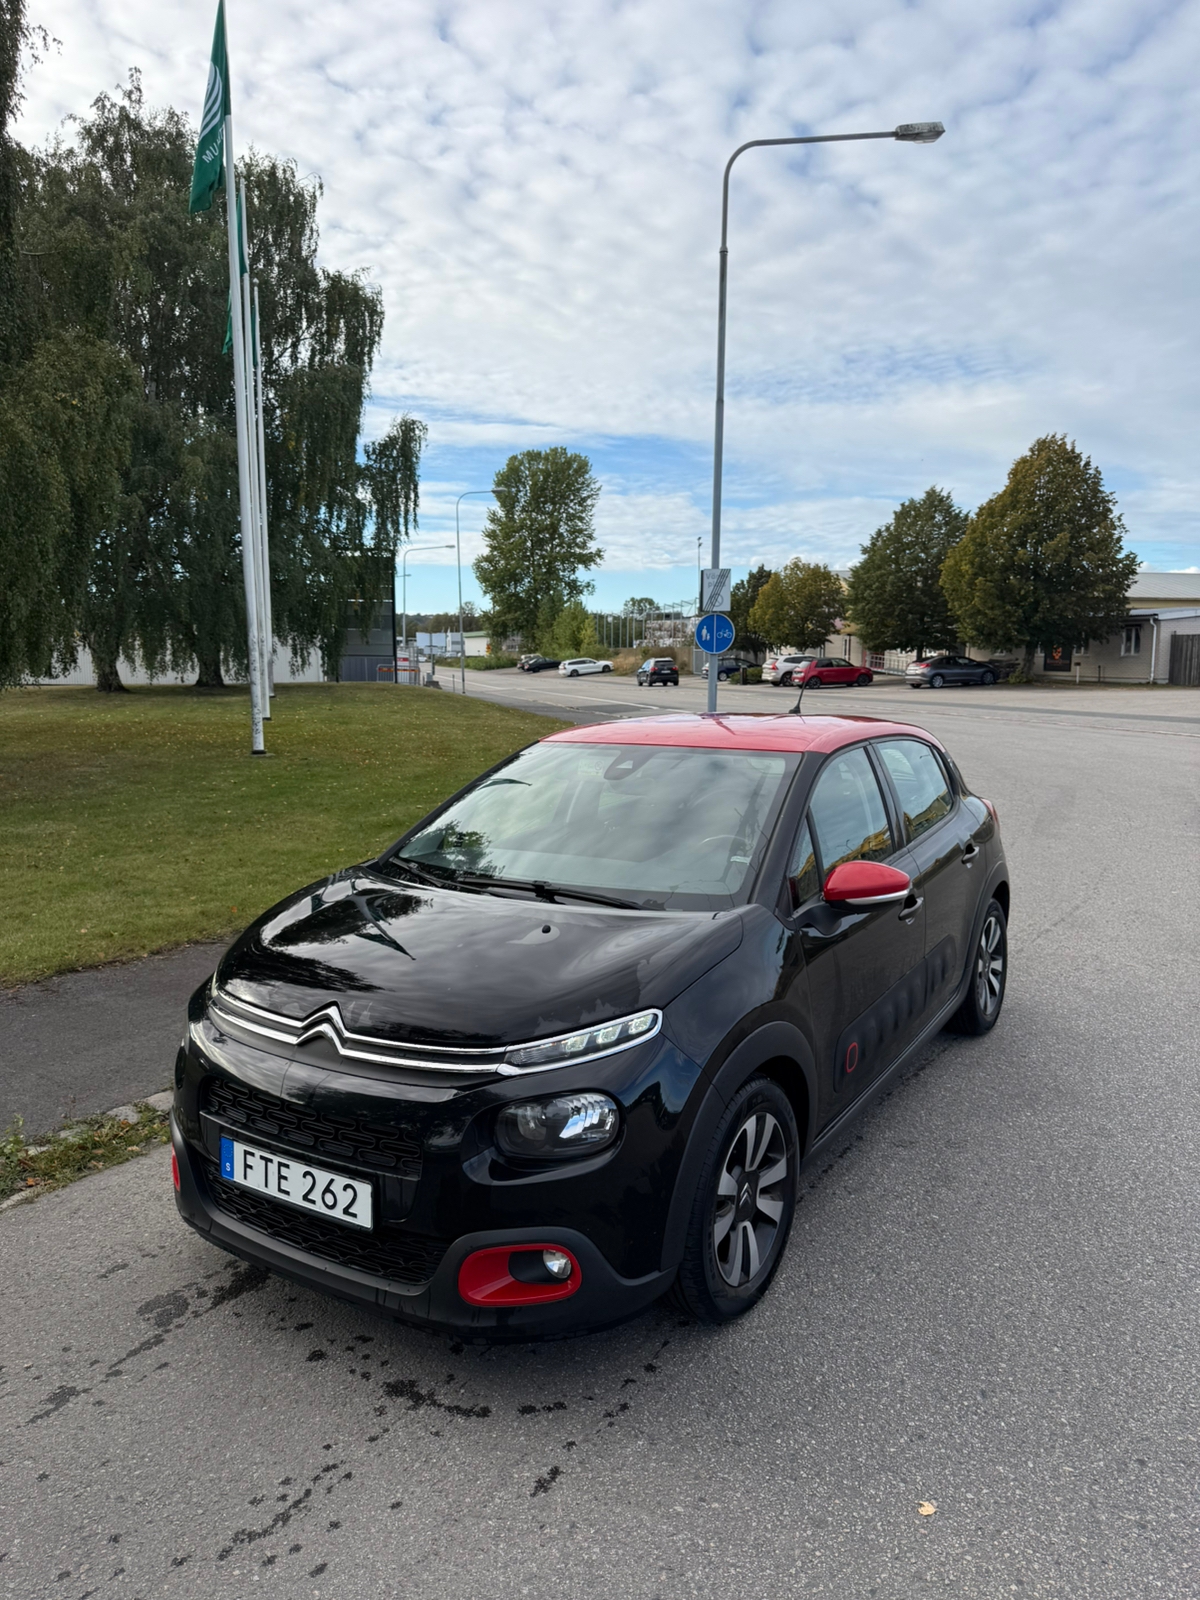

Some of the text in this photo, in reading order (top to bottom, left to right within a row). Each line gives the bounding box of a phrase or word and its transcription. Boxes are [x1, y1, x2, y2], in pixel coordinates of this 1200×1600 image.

[225, 1162, 231, 1172] S
[243, 1149, 358, 1219] FTE 262
